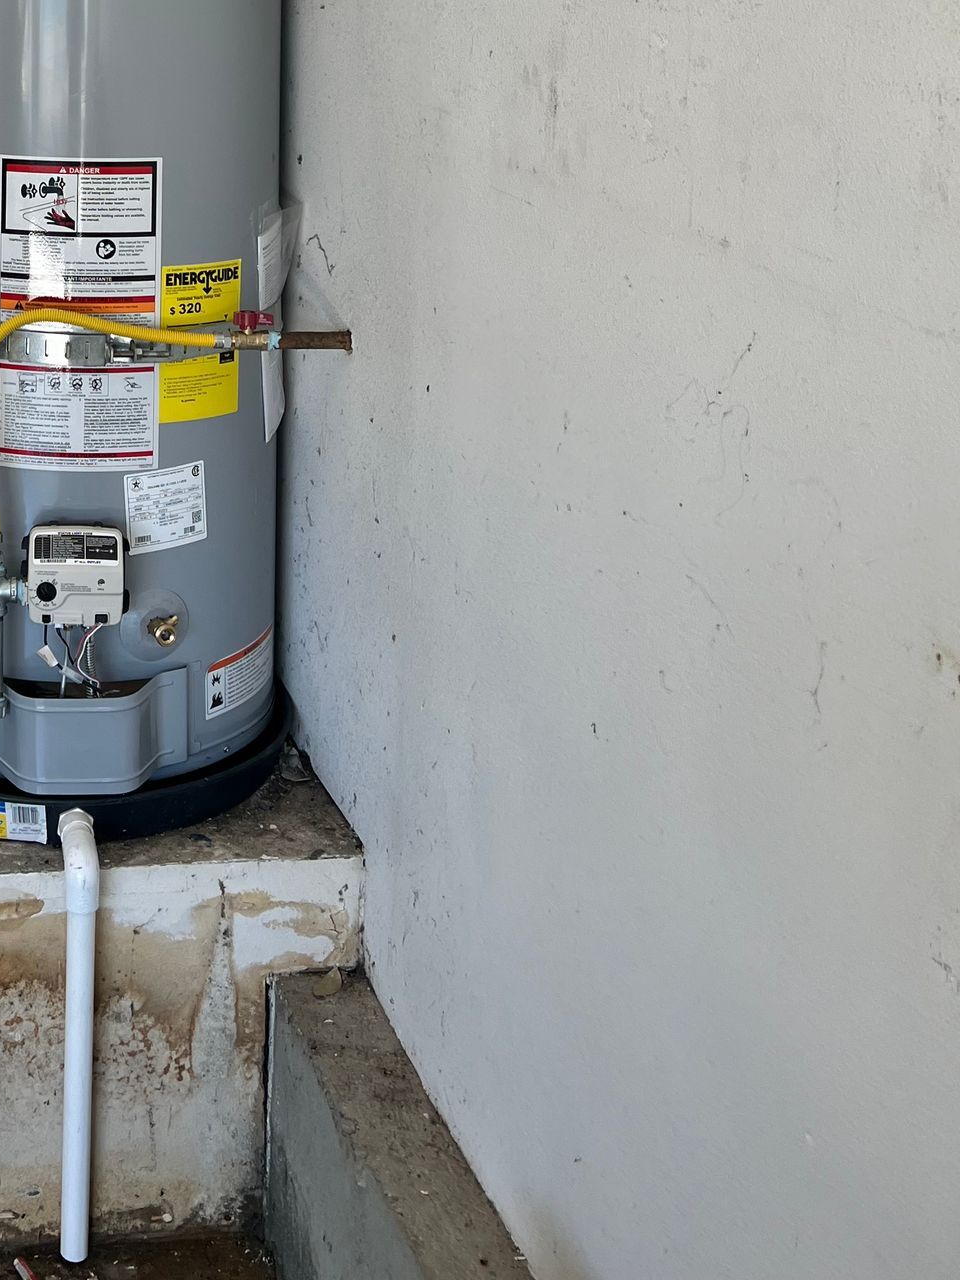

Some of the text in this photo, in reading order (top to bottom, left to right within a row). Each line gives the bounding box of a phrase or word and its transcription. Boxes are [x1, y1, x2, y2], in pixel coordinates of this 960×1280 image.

[166, 266, 239, 289] ENERGYGUIDE
[170, 302, 201, 315] $ 320
